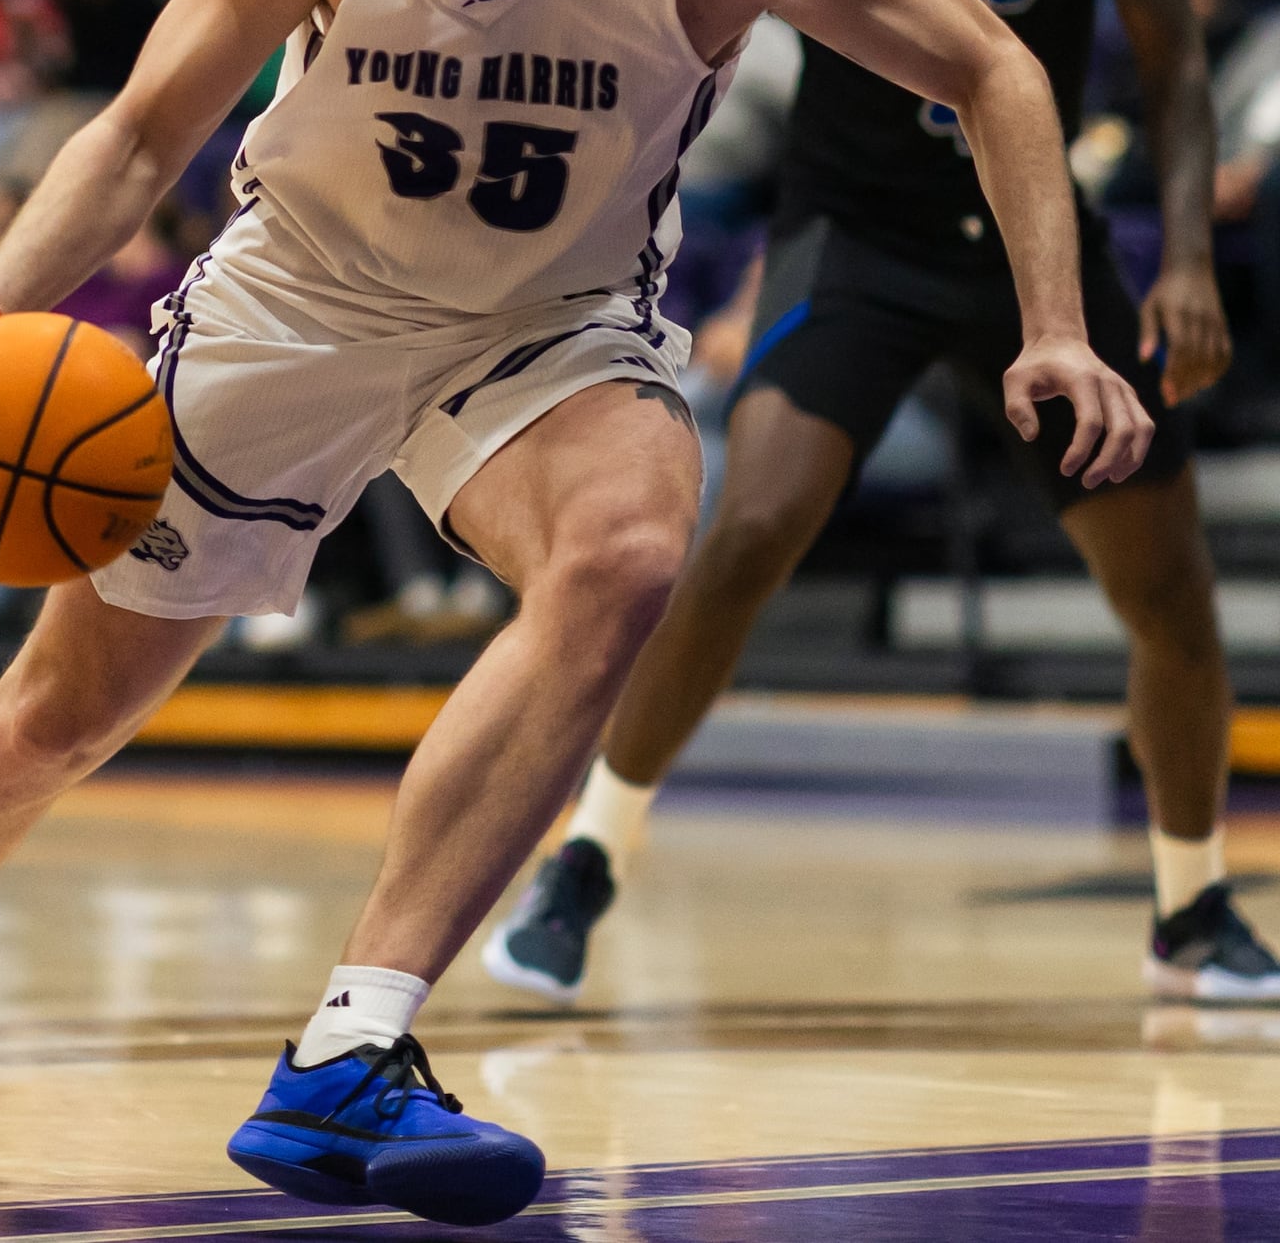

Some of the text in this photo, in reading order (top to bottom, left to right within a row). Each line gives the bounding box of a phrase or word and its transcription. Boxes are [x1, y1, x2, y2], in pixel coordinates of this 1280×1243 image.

[345, 48, 619, 111] YOUNG HARRIS
[374, 112, 579, 233] 35
